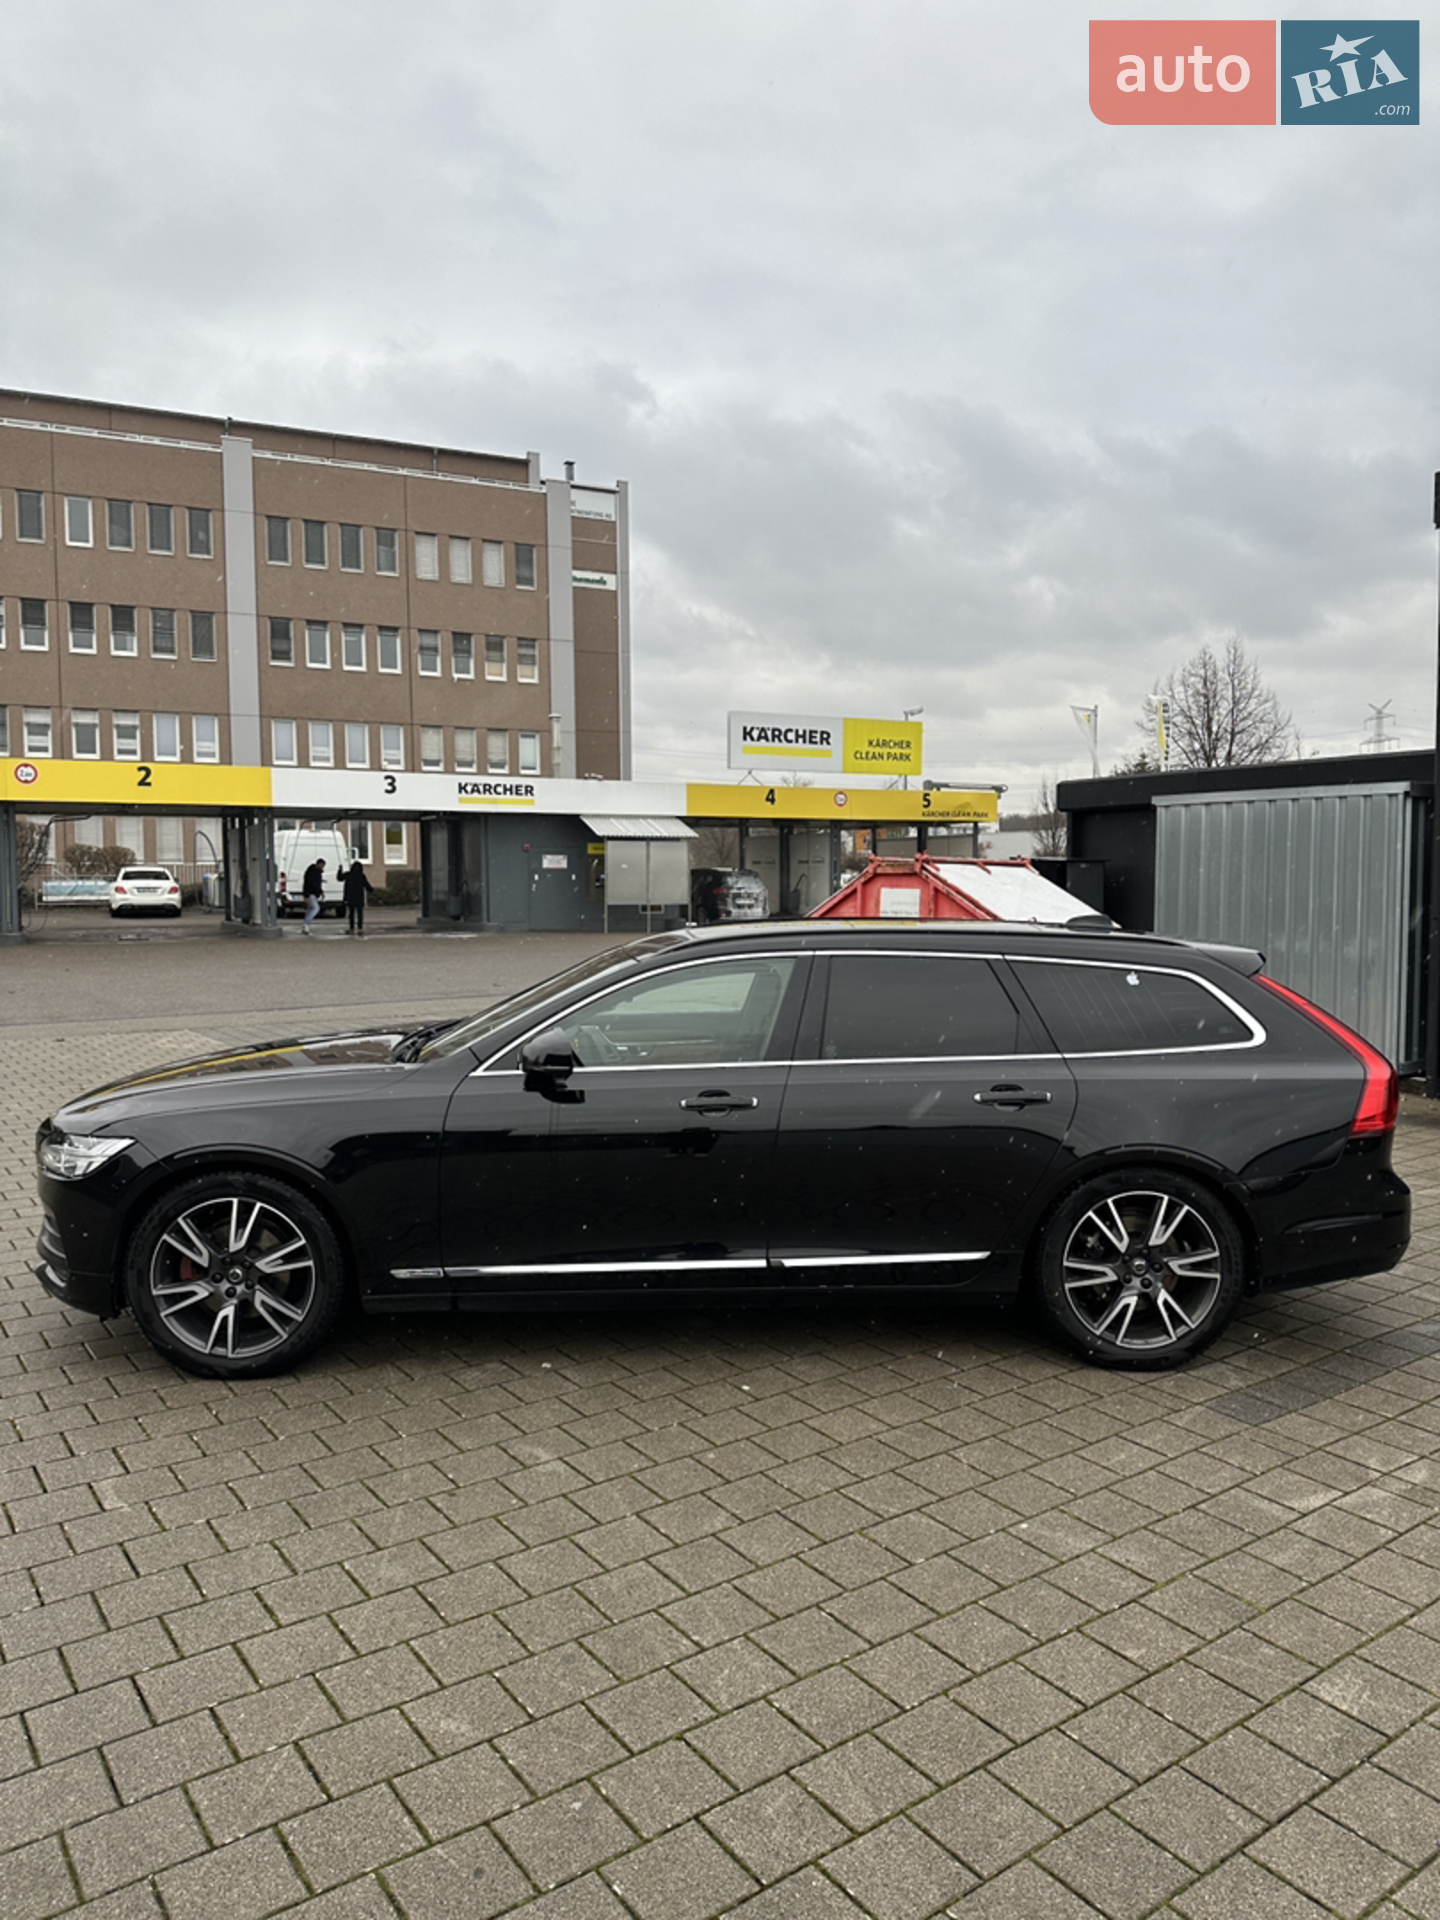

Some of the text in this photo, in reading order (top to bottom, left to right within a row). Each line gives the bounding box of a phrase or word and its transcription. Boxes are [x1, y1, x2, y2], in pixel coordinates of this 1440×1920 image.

[742, 725, 832, 746] KÄRCHER
[867, 738, 912, 750] KÄRCHER
[853, 750, 911, 762] CLEAN PARK
[136, 766, 152, 787] 2
[383, 775, 397, 794] 3
[458, 782, 535, 797] KÄRCHER
[765, 788, 776, 805] 4
[922, 792, 931, 808] 5
